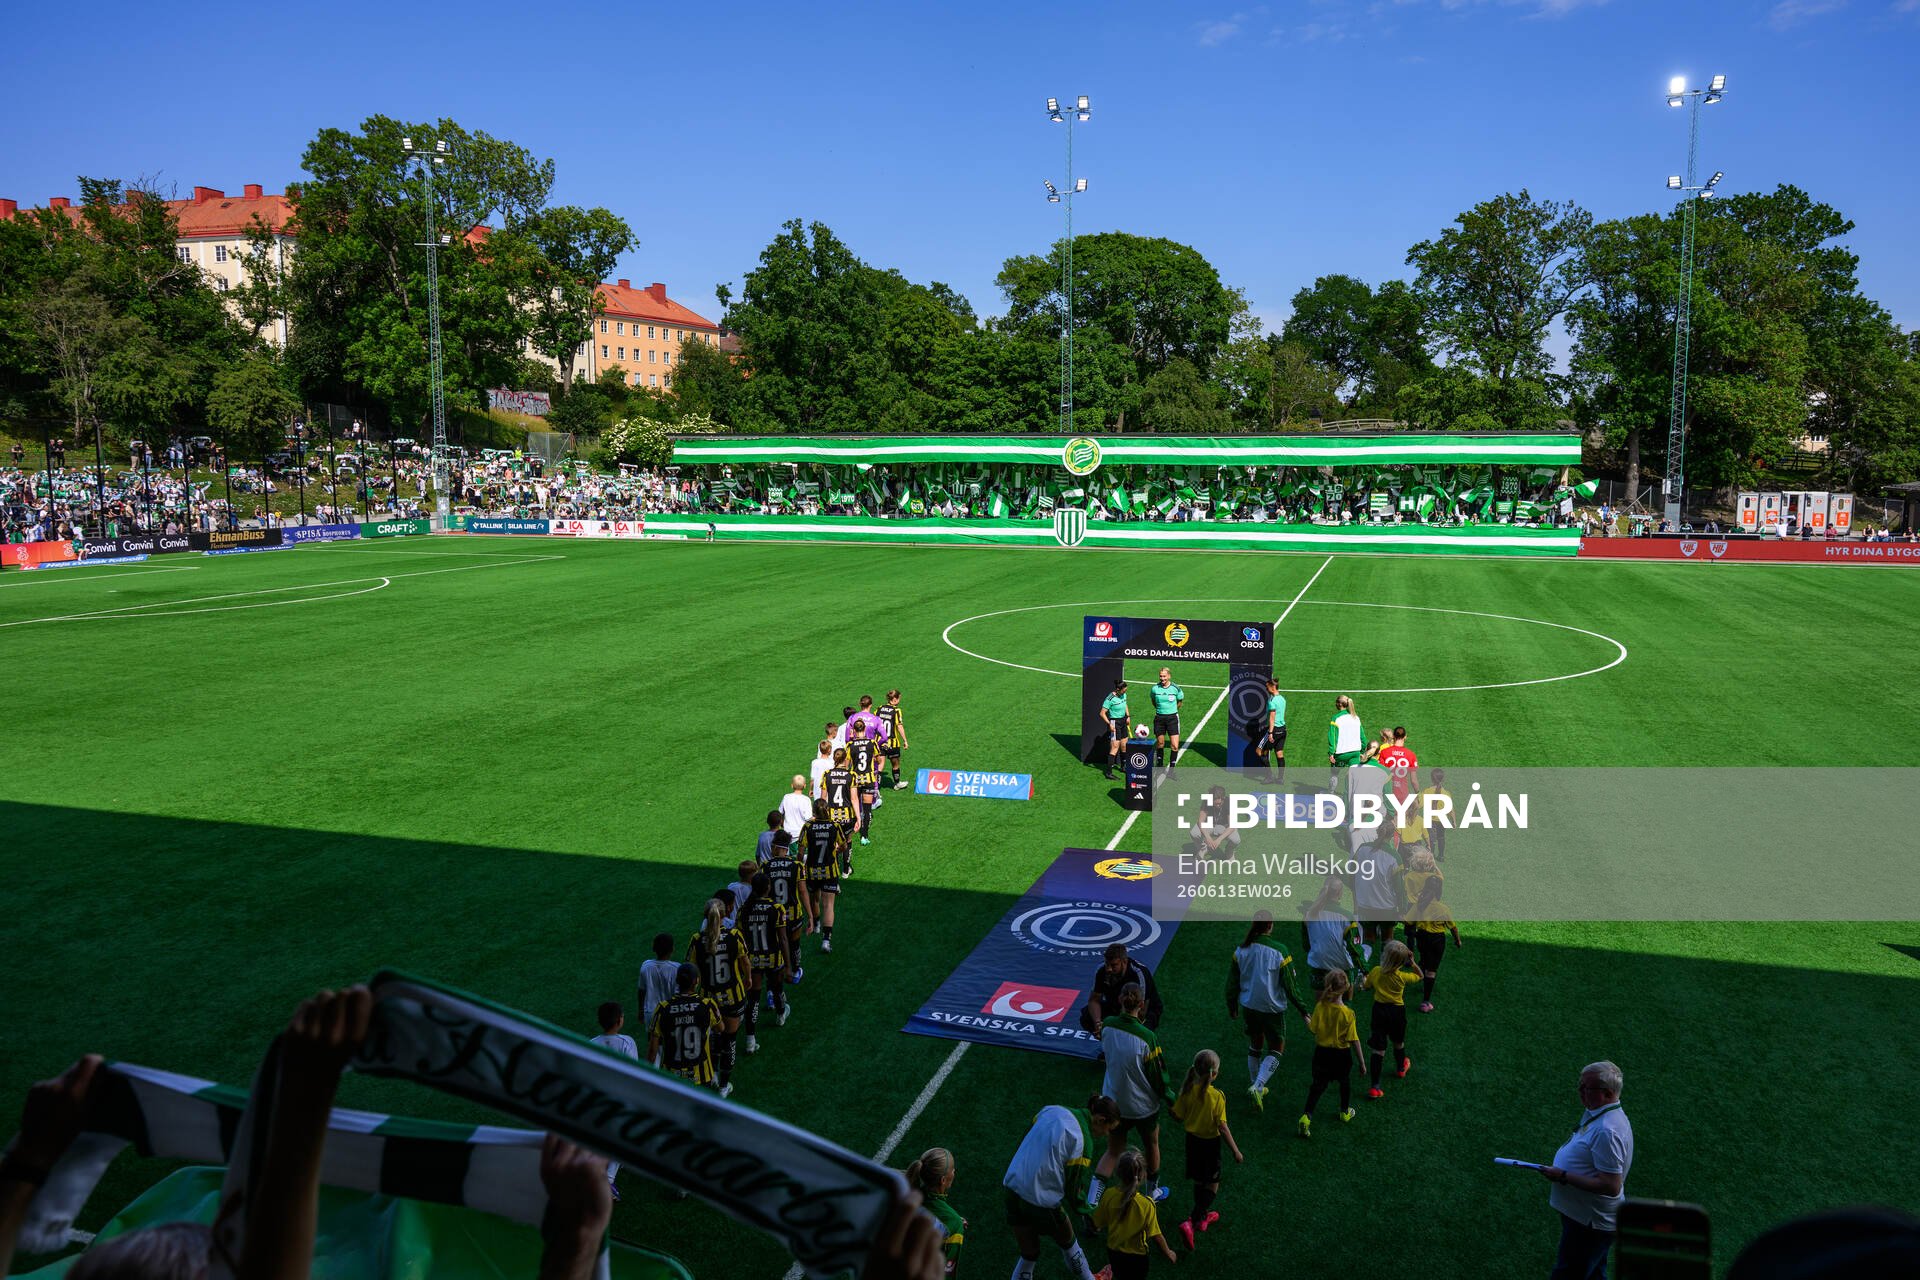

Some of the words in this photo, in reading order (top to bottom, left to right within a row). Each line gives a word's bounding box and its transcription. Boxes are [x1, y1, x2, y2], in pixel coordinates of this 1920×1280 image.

[378, 524, 409, 534] CRAFT
[569, 521, 584, 530] ICA
[615, 522, 629, 531] ICA
[210, 530, 265, 543] EkmanBuss
[296, 528, 321, 539] SPISA
[84, 541, 117, 555] Convini
[123, 538, 154, 552] Convini
[160, 536, 189, 550] Convini
[1825, 547, 1850, 556] HYR
[1853, 547, 1884, 556] DINA
[1240, 640, 1265, 649] OBOS
[1124, 648, 1148, 657] OBOS
[1150, 649, 1230, 661] DAMALLSVENSKAN
[858, 751, 868, 772] 3
[955, 772, 1018, 786] SVENSKA
[833, 785, 845, 807] 4
[953, 784, 987, 797] SPEL
[815, 840, 828, 864] 7
[774, 878, 789, 905] 9
[1075, 901, 1130, 912] OBOS
[750, 922, 769, 951] 11
[704, 952, 732, 987] 15
[669, 1002, 701, 1014] SKF
[930, 1011, 1037, 1034] SVENSKA
[669, 1025, 702, 1062] 19
